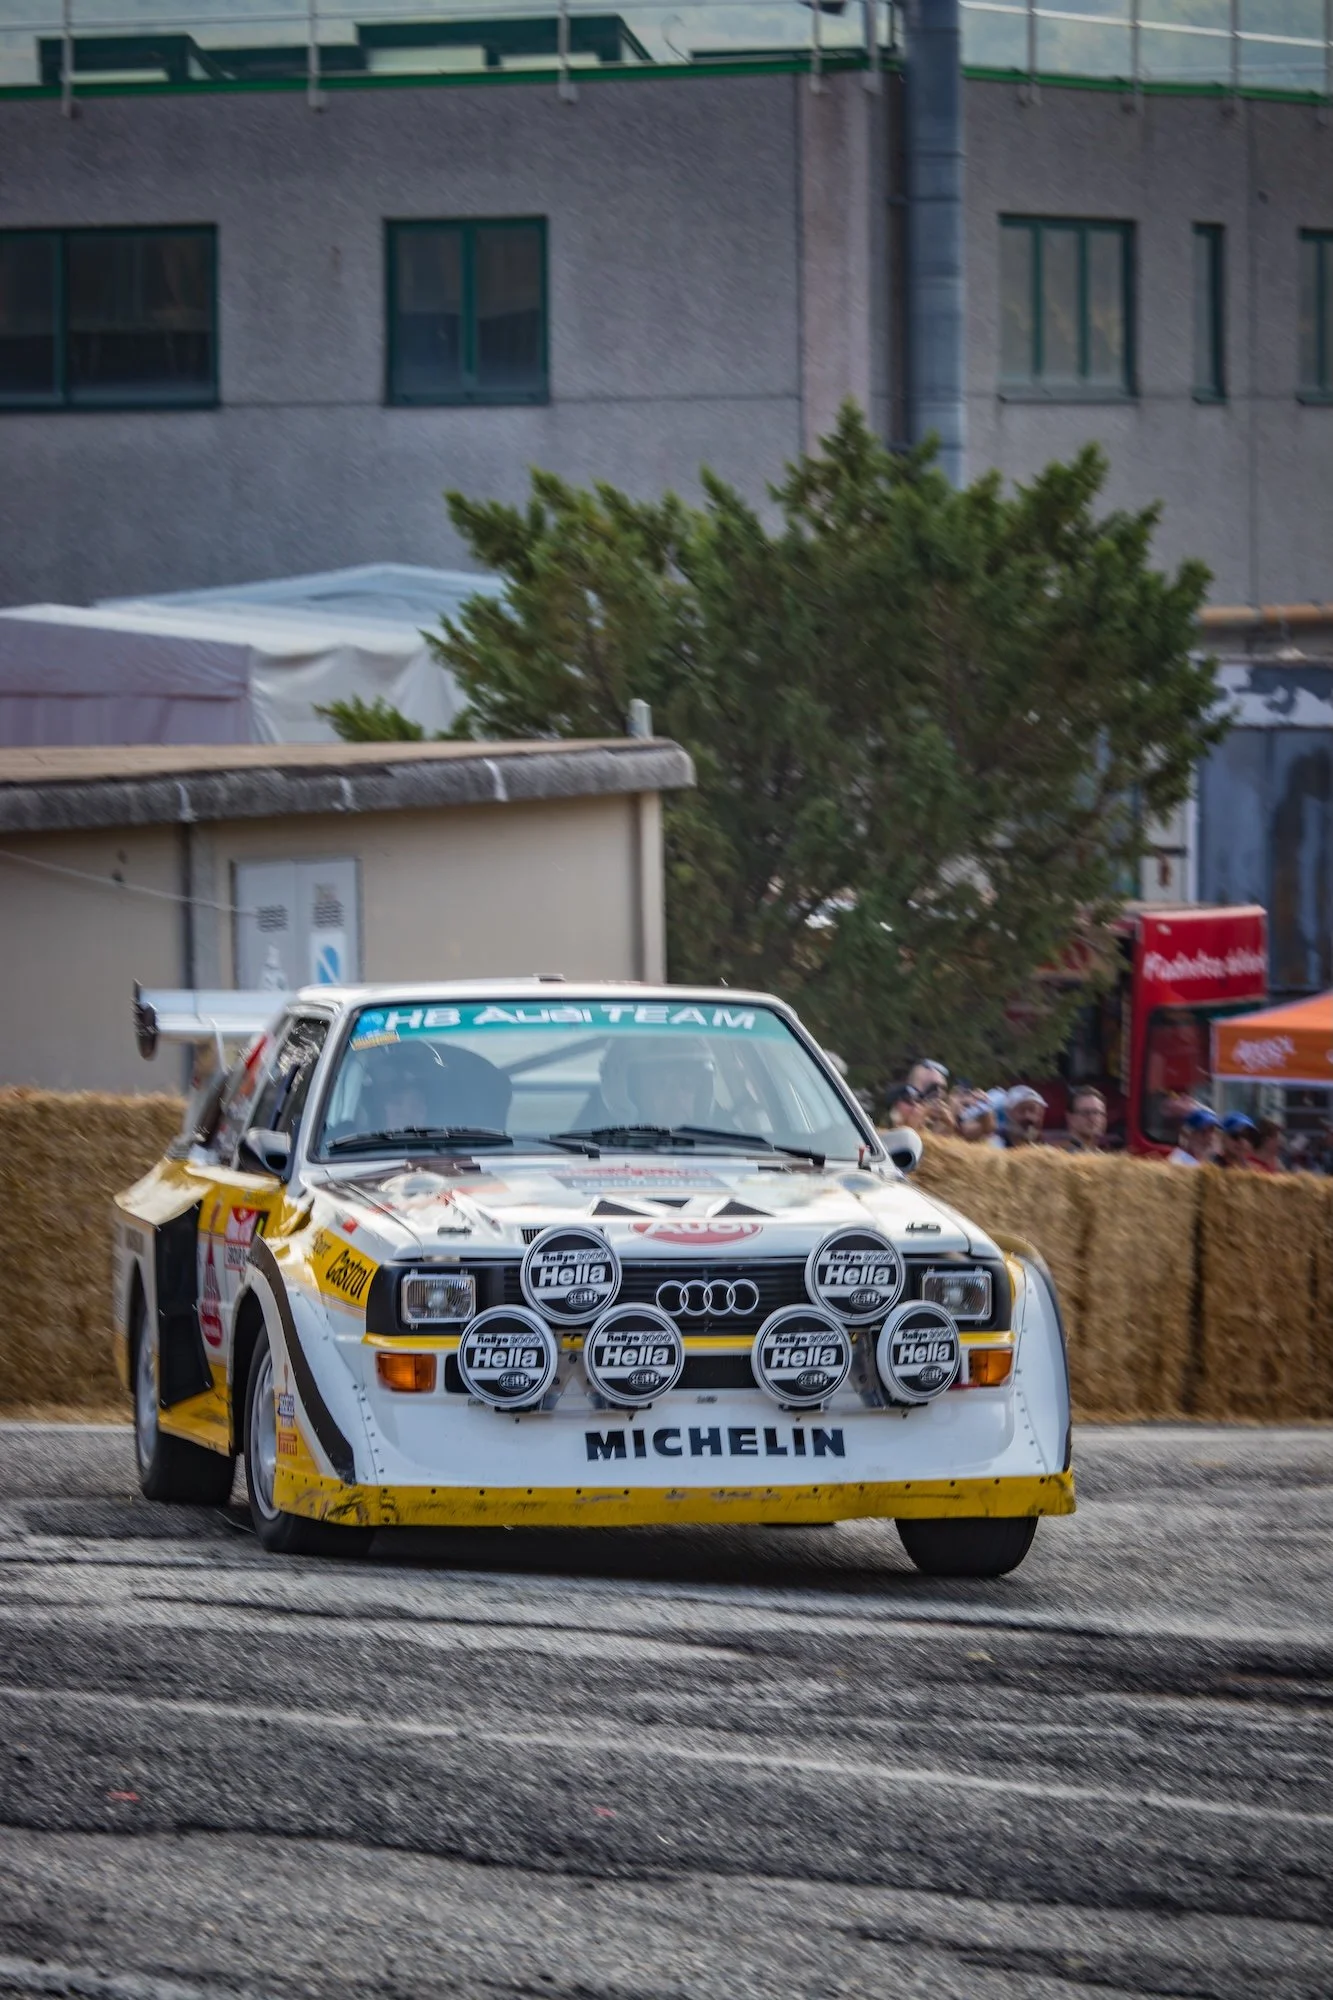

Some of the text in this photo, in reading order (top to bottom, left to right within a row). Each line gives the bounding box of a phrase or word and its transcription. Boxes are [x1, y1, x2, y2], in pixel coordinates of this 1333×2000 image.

[385, 1008, 461, 1031] HB
[601, 1005, 756, 1030] TEAM
[542, 1252, 575, 1264] Rallye
[829, 1252, 862, 1264] Rallye
[325, 1247, 374, 1300] Castrol
[538, 1264, 606, 1287] Hella
[824, 1264, 891, 1285] Hella
[477, 1335, 509, 1347] Rallye
[606, 1334, 640, 1345] Rallye
[775, 1334, 807, 1346] Rallye
[472, 1348, 538, 1368] Hella
[601, 1346, 669, 1366] Hella
[770, 1347, 837, 1368] Hella
[898, 1342, 951, 1364] Hella
[585, 1426, 846, 1462] MICHELIN
